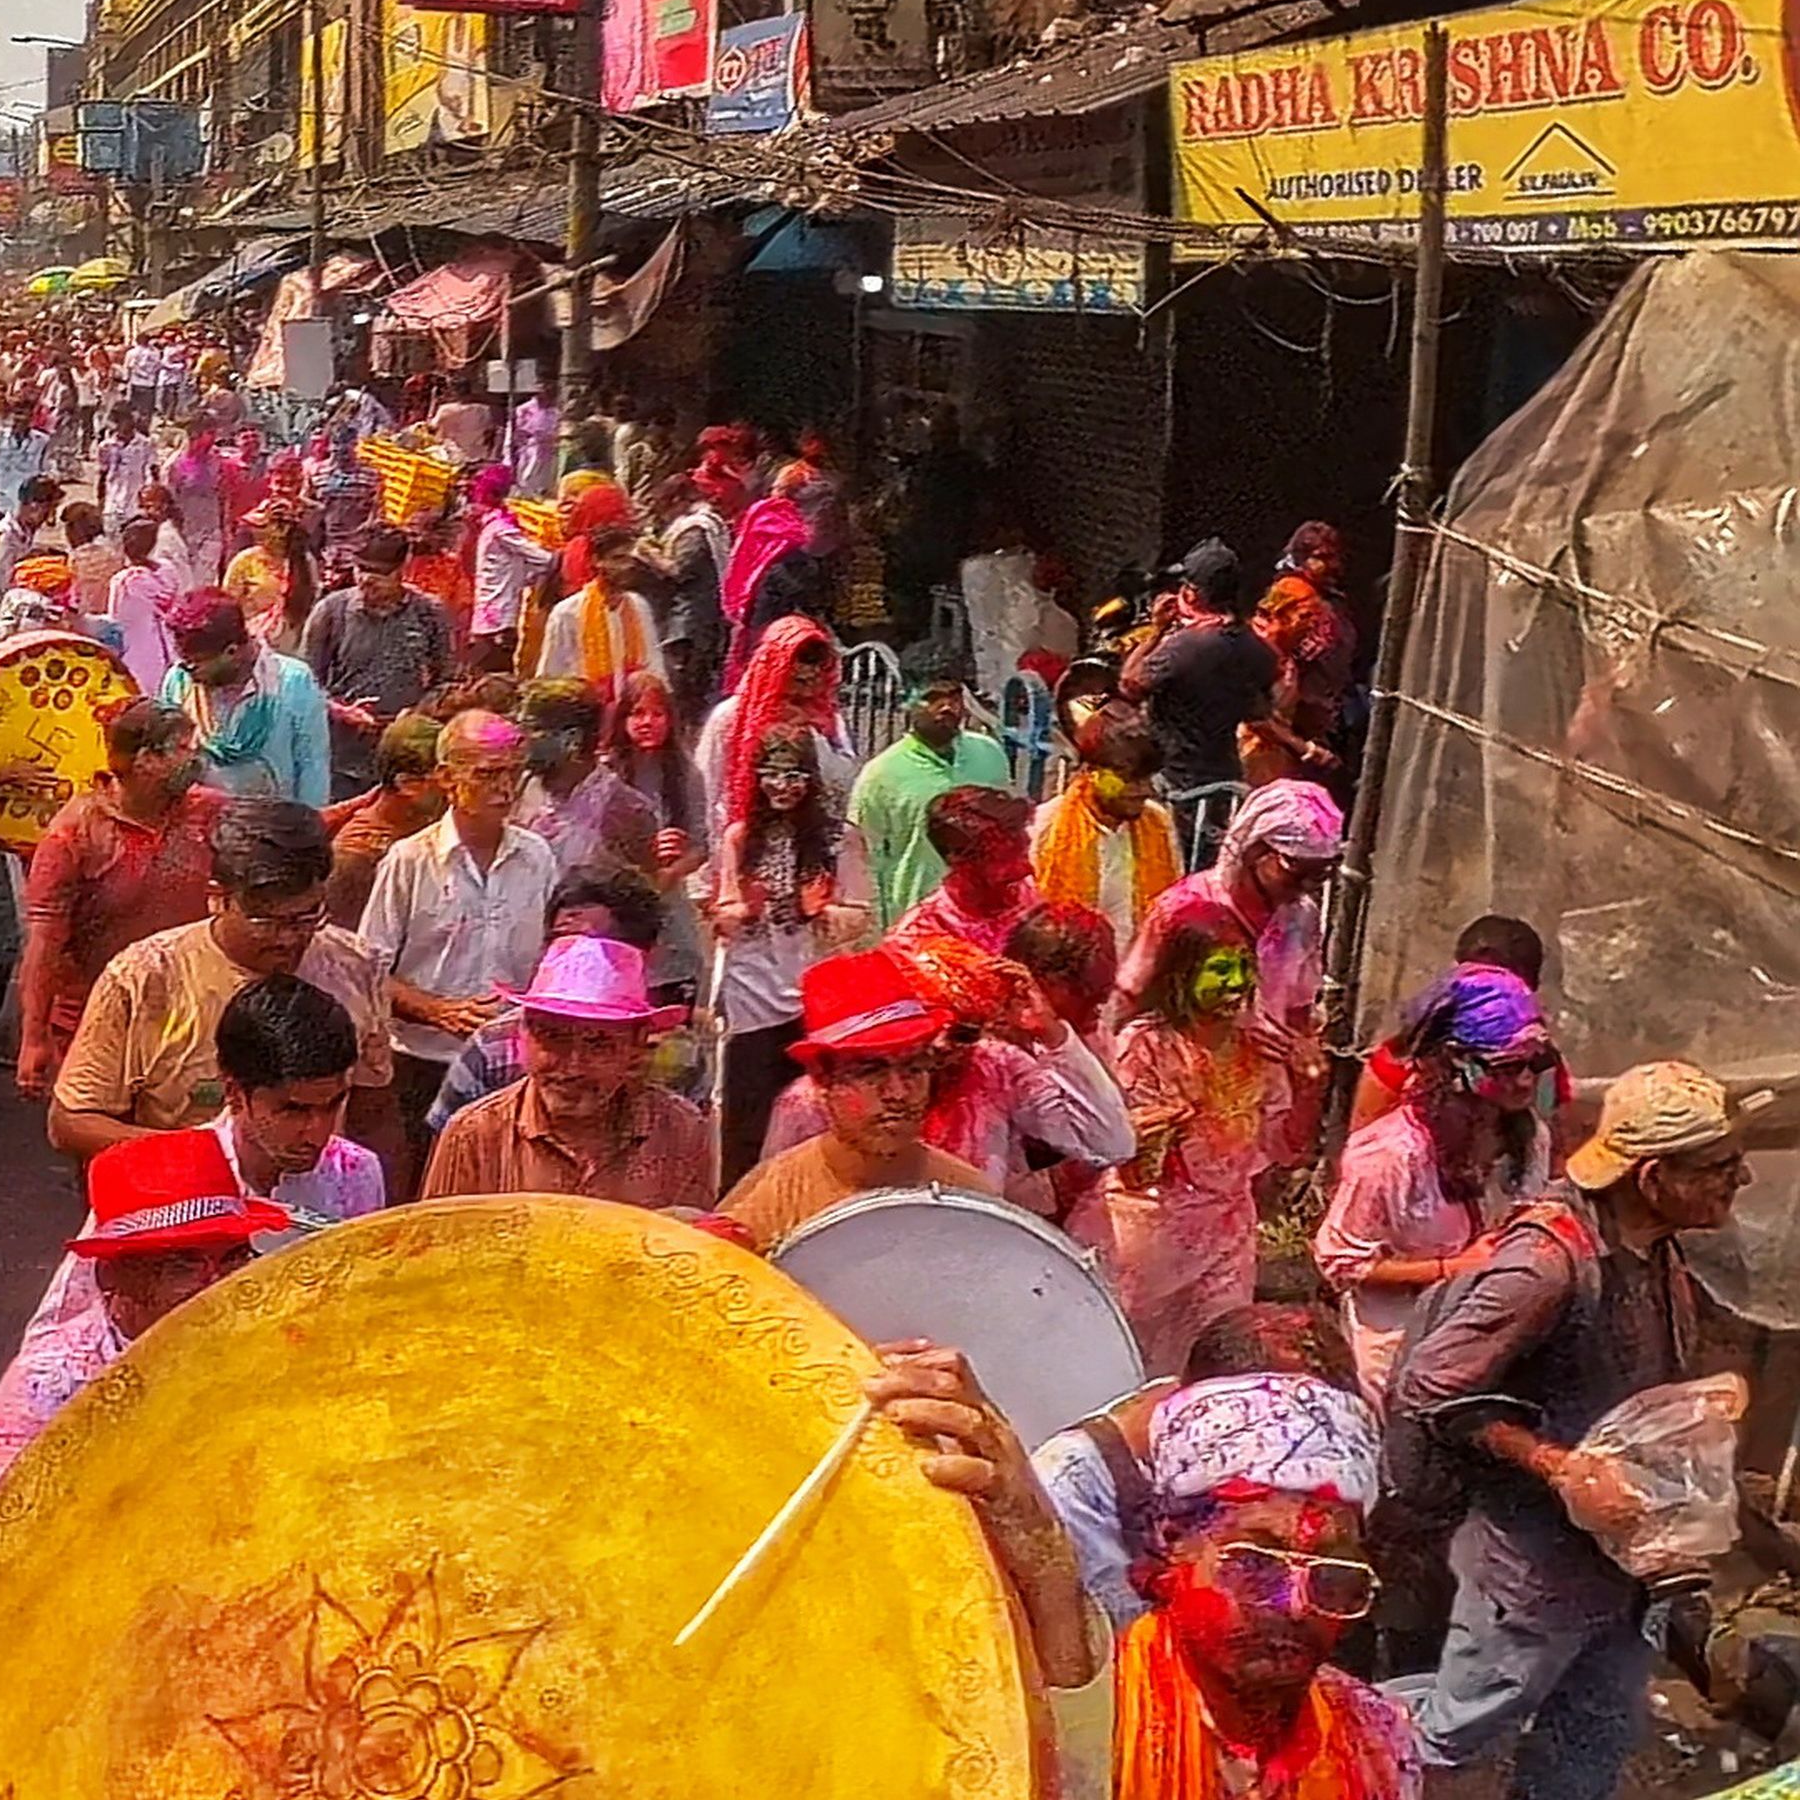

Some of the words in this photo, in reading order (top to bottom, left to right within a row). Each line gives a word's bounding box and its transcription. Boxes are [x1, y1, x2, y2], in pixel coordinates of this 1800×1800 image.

[1181, 61, 1340, 141] RADHA
[1347, 14, 1626, 126] KRSHNA
[1265, 167, 1392, 201] AUTHORISED
[1566, 214, 1618, 240] Mob
[1643, 206, 1800, 236] 9903766797
